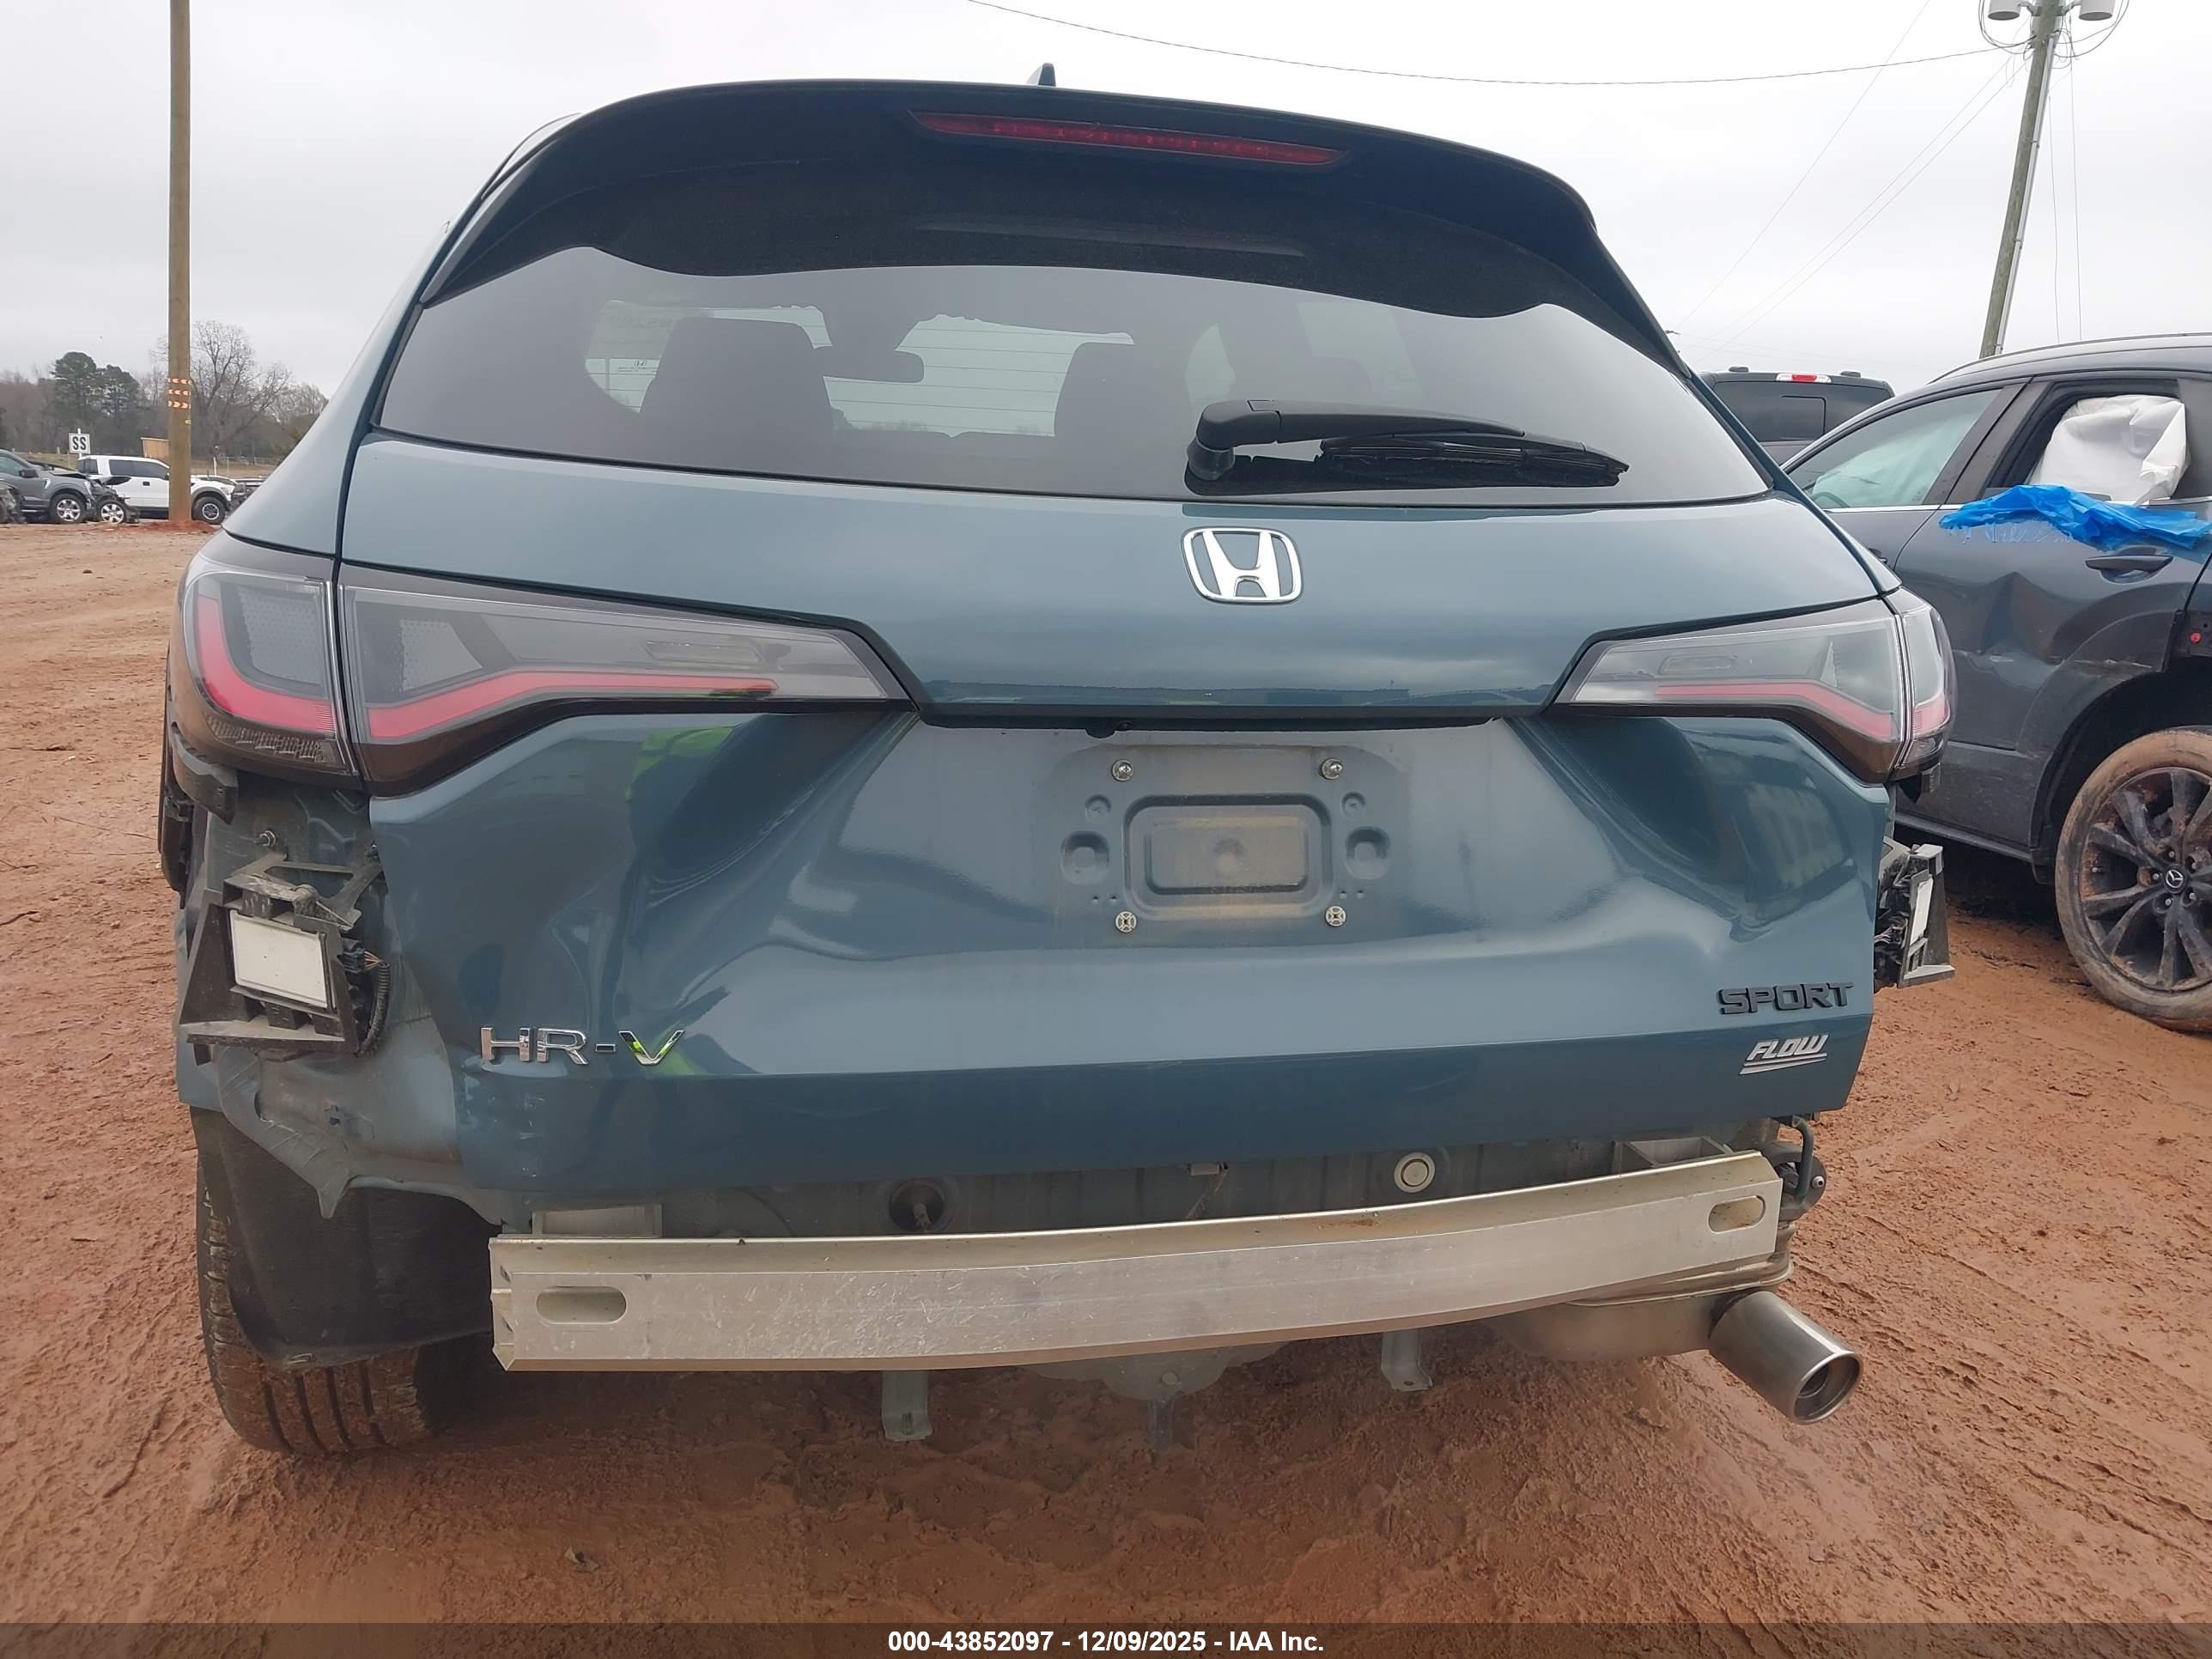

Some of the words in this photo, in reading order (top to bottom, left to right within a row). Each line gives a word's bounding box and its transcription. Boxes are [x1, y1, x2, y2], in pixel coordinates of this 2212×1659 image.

[72, 435, 87, 451] SS
[1717, 981, 1855, 1015] SPORT
[480, 1026, 684, 1066] HR-V
[1744, 1033, 1830, 1061] FLOW
